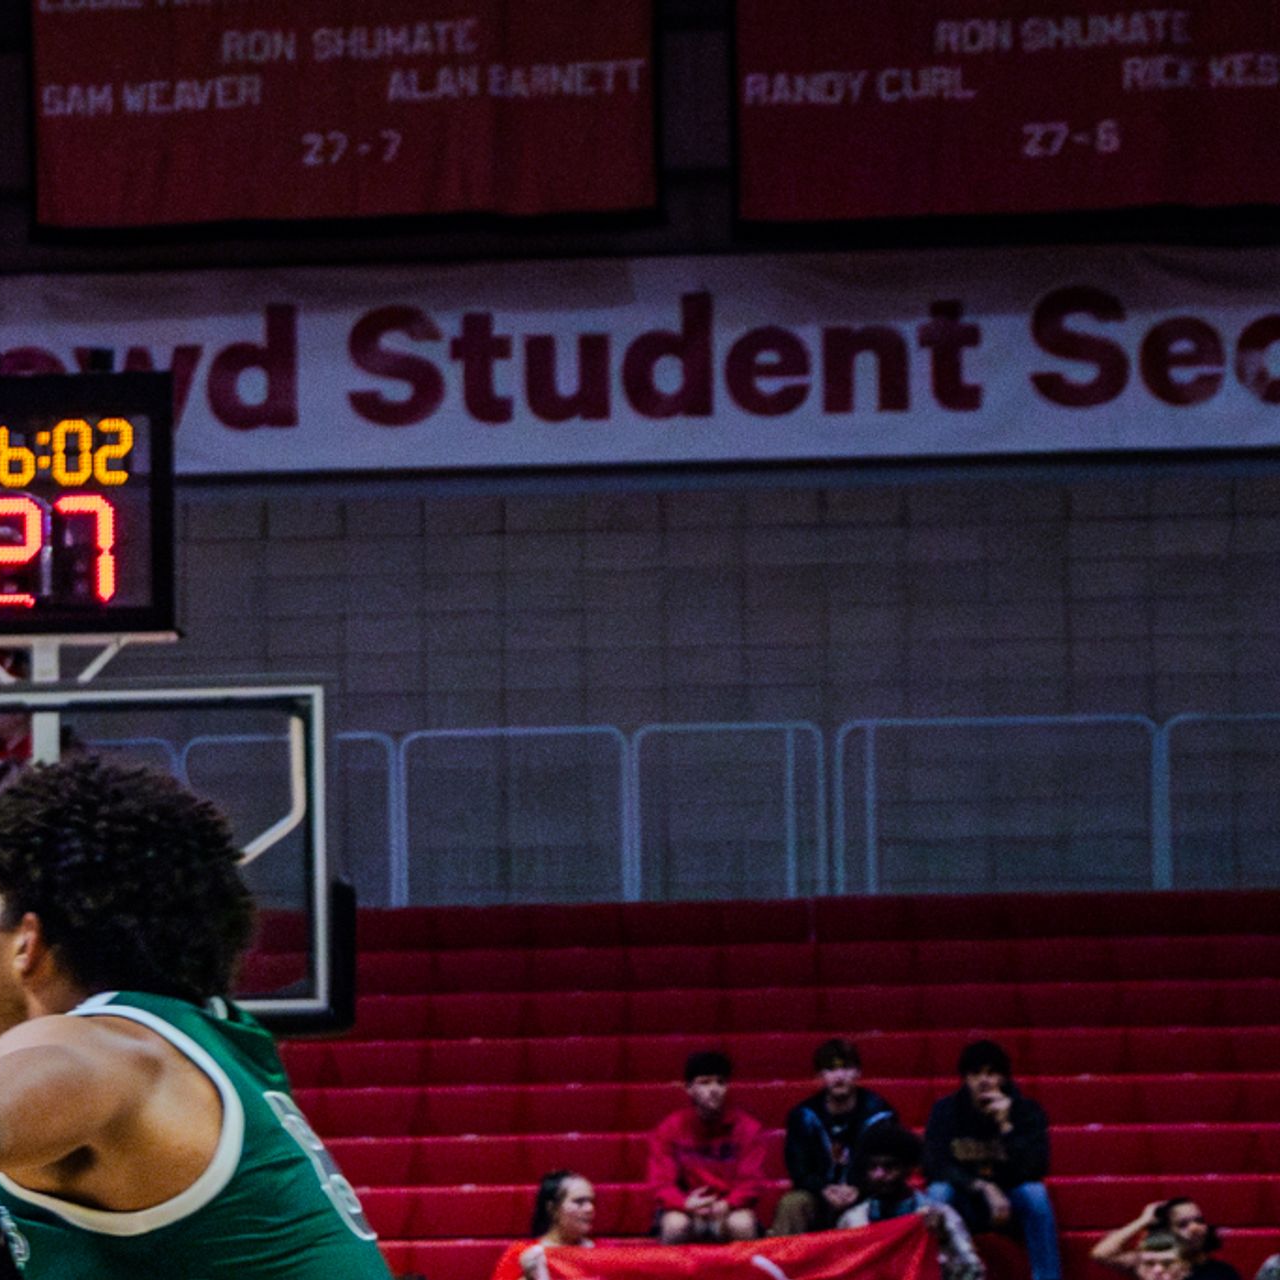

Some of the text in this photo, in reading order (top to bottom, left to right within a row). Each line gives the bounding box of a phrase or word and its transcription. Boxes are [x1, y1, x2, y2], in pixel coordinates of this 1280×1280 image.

[220, 29, 297, 64] RON
[41, 72, 263, 117] SAM WEAVER
[347, 290, 983, 429] Student
